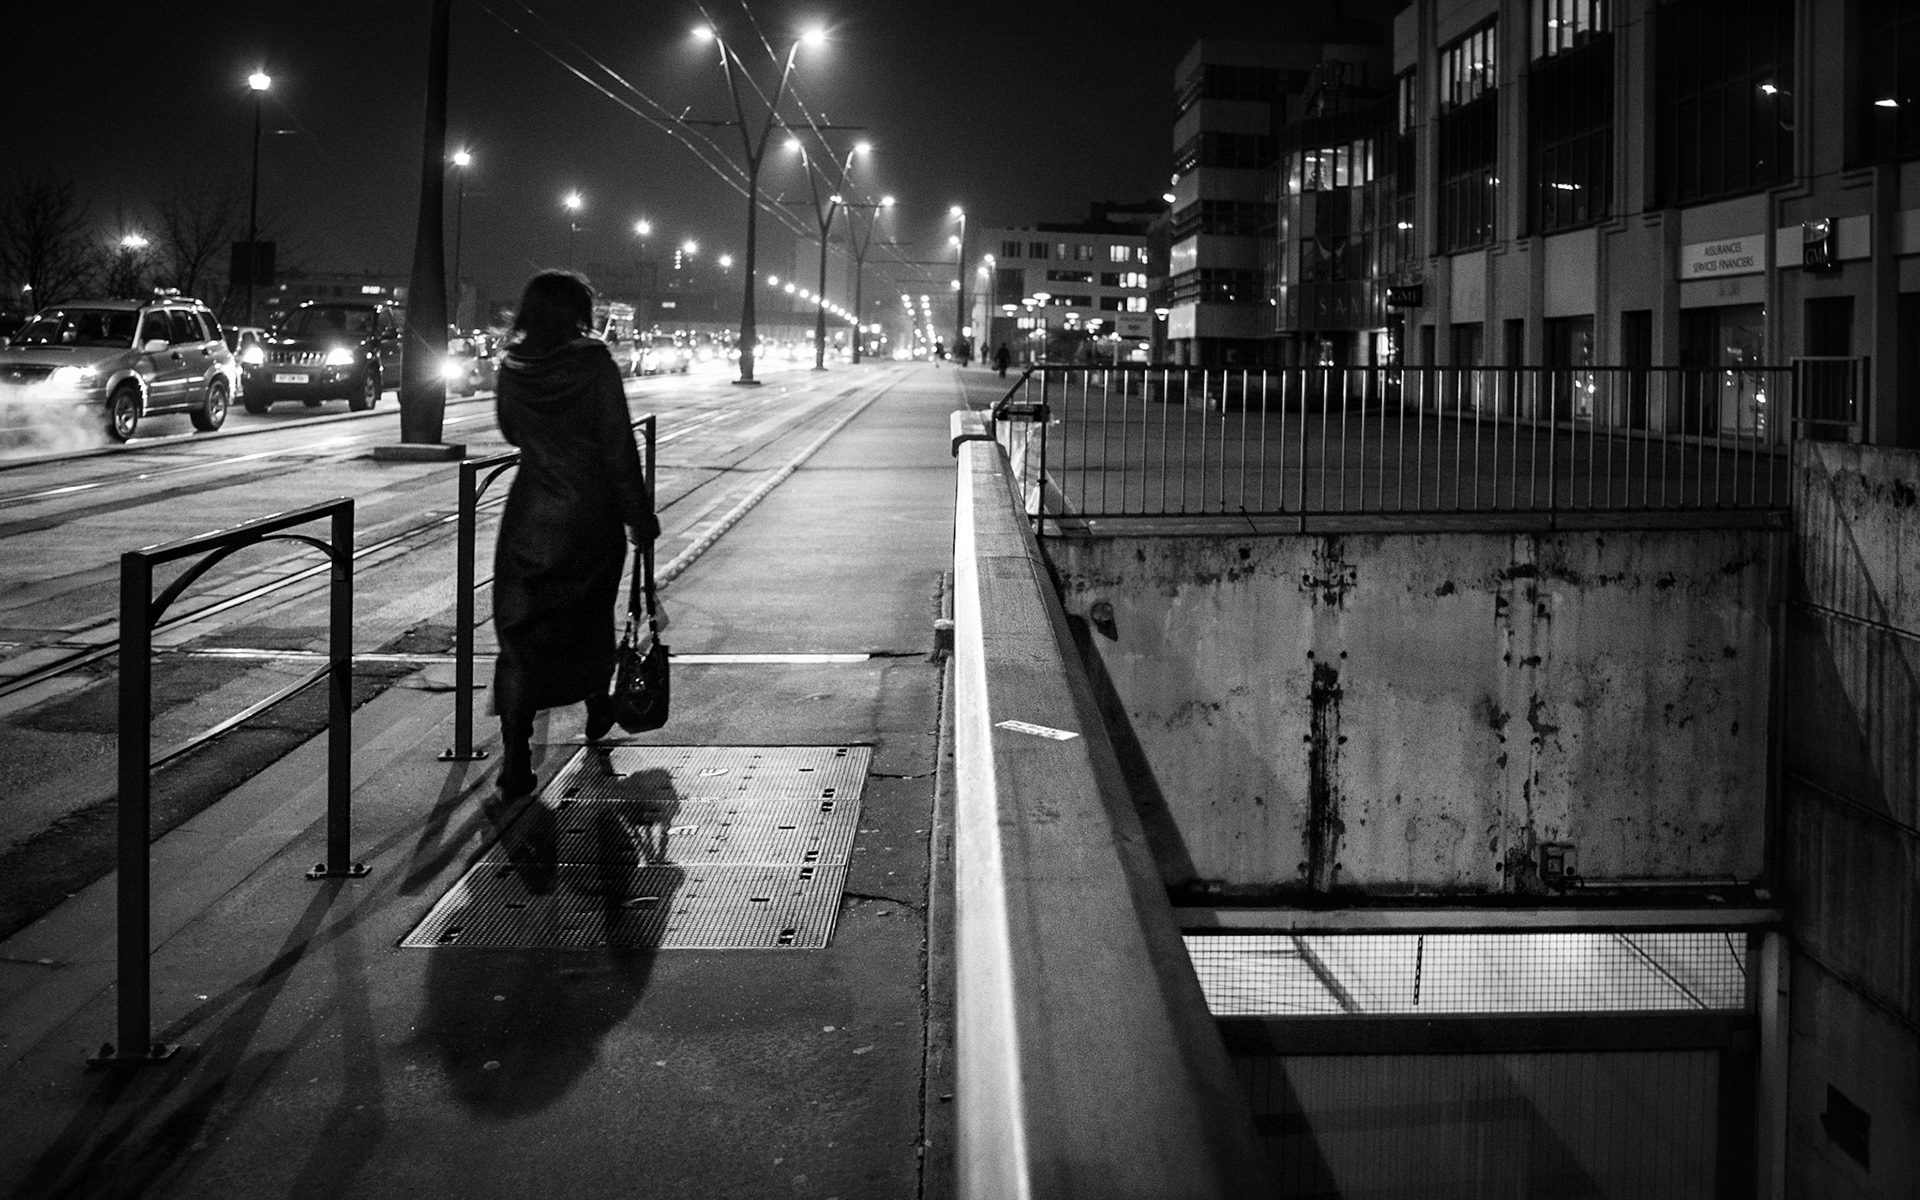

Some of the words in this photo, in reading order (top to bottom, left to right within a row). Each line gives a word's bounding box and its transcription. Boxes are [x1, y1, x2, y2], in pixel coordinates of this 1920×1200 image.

[1705, 242, 1742, 256] ASSURANCES
[1693, 261, 1717, 272] SERVICES
[1718, 256, 1754, 270] FINANCIERS
